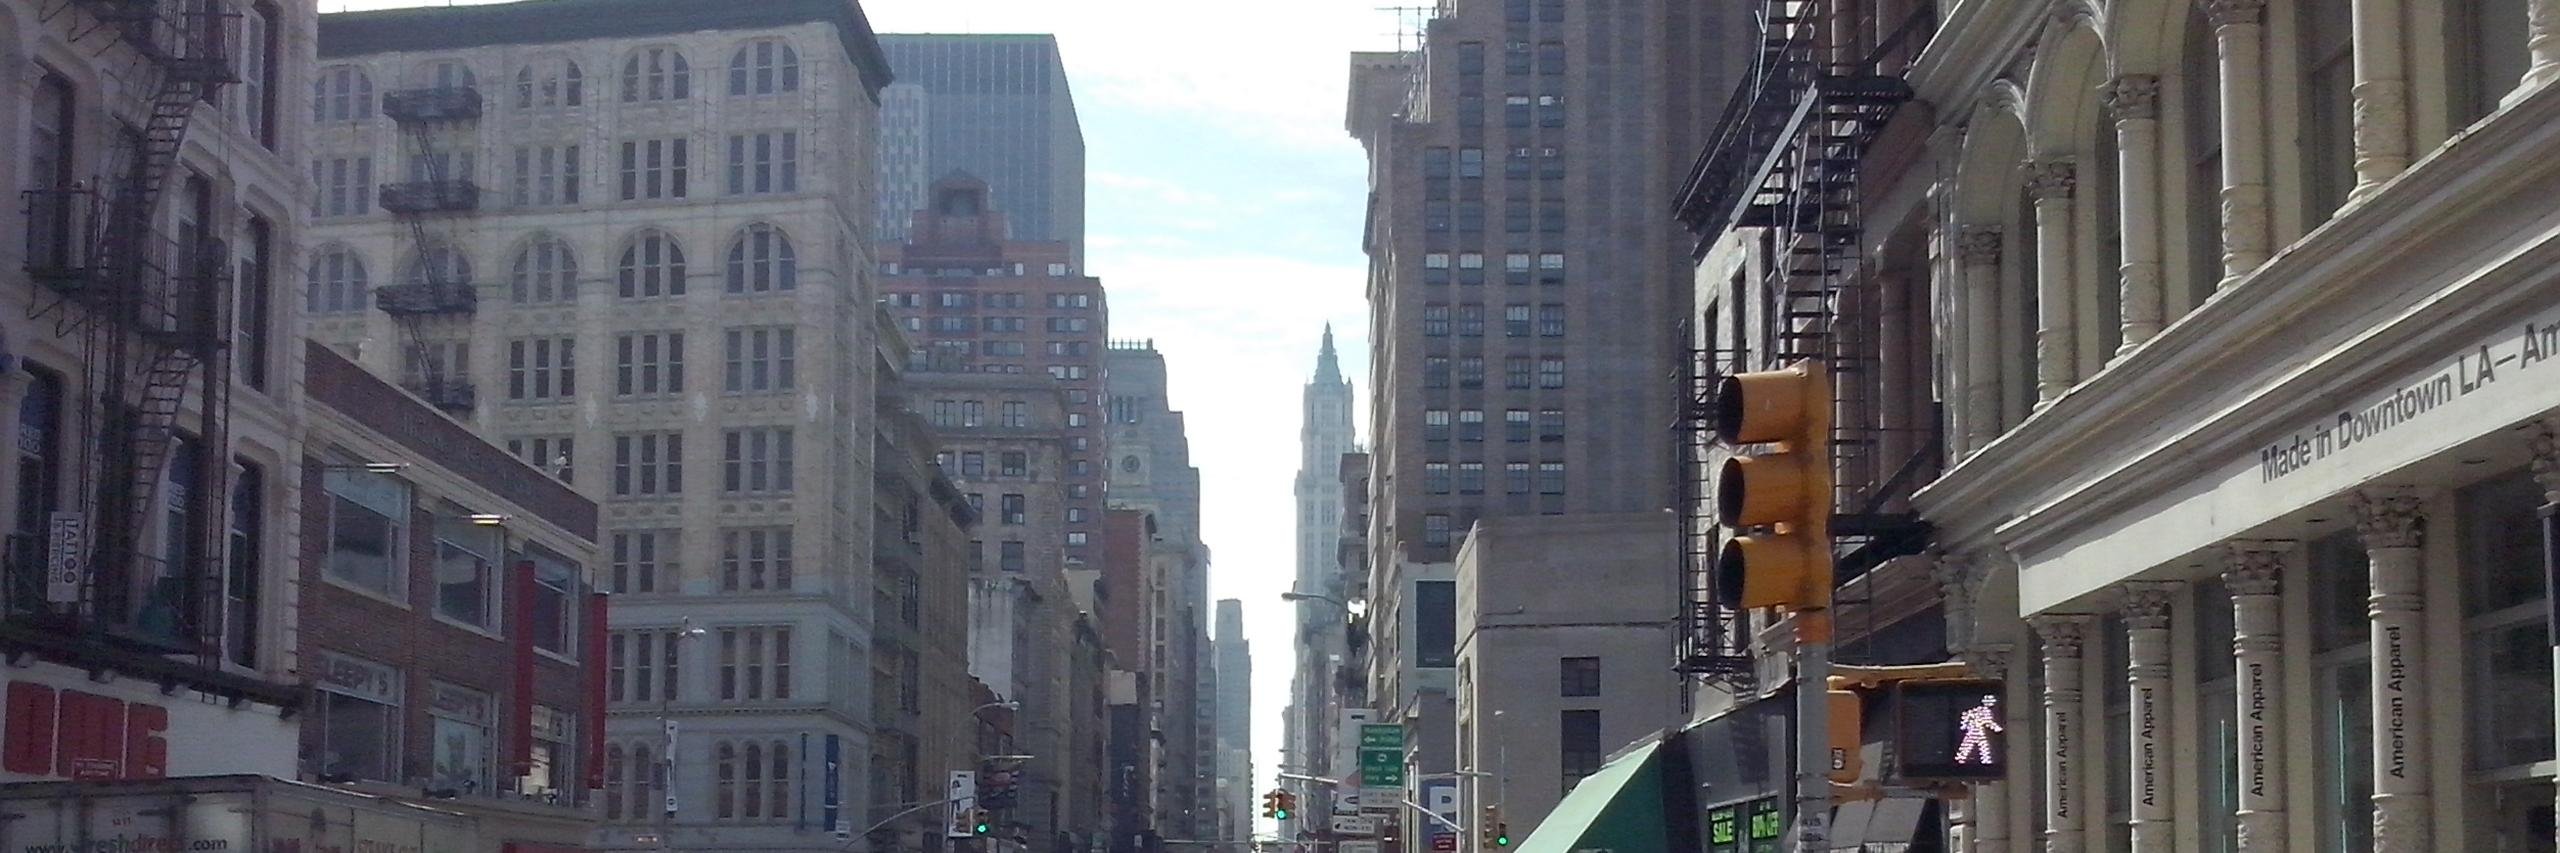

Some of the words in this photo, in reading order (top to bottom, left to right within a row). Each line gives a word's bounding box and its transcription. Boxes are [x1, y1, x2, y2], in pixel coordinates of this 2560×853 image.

[2261, 435, 2311, 484] Made
[2316, 424, 2333, 459] in
[2338, 372, 2451, 450] Downtown
[2386, 625, 2406, 692] Apparel
[2141, 688, 2155, 739] Apparel
[2250, 663, 2265, 721] Apparel
[2056, 712, 2069, 758] Apparel
[2251, 725, 2264, 797] American
[2389, 698, 2405, 779] American
[2057, 761, 2068, 818] American
[2143, 743, 2154, 806] American
[1713, 820, 1734, 843] SALE
